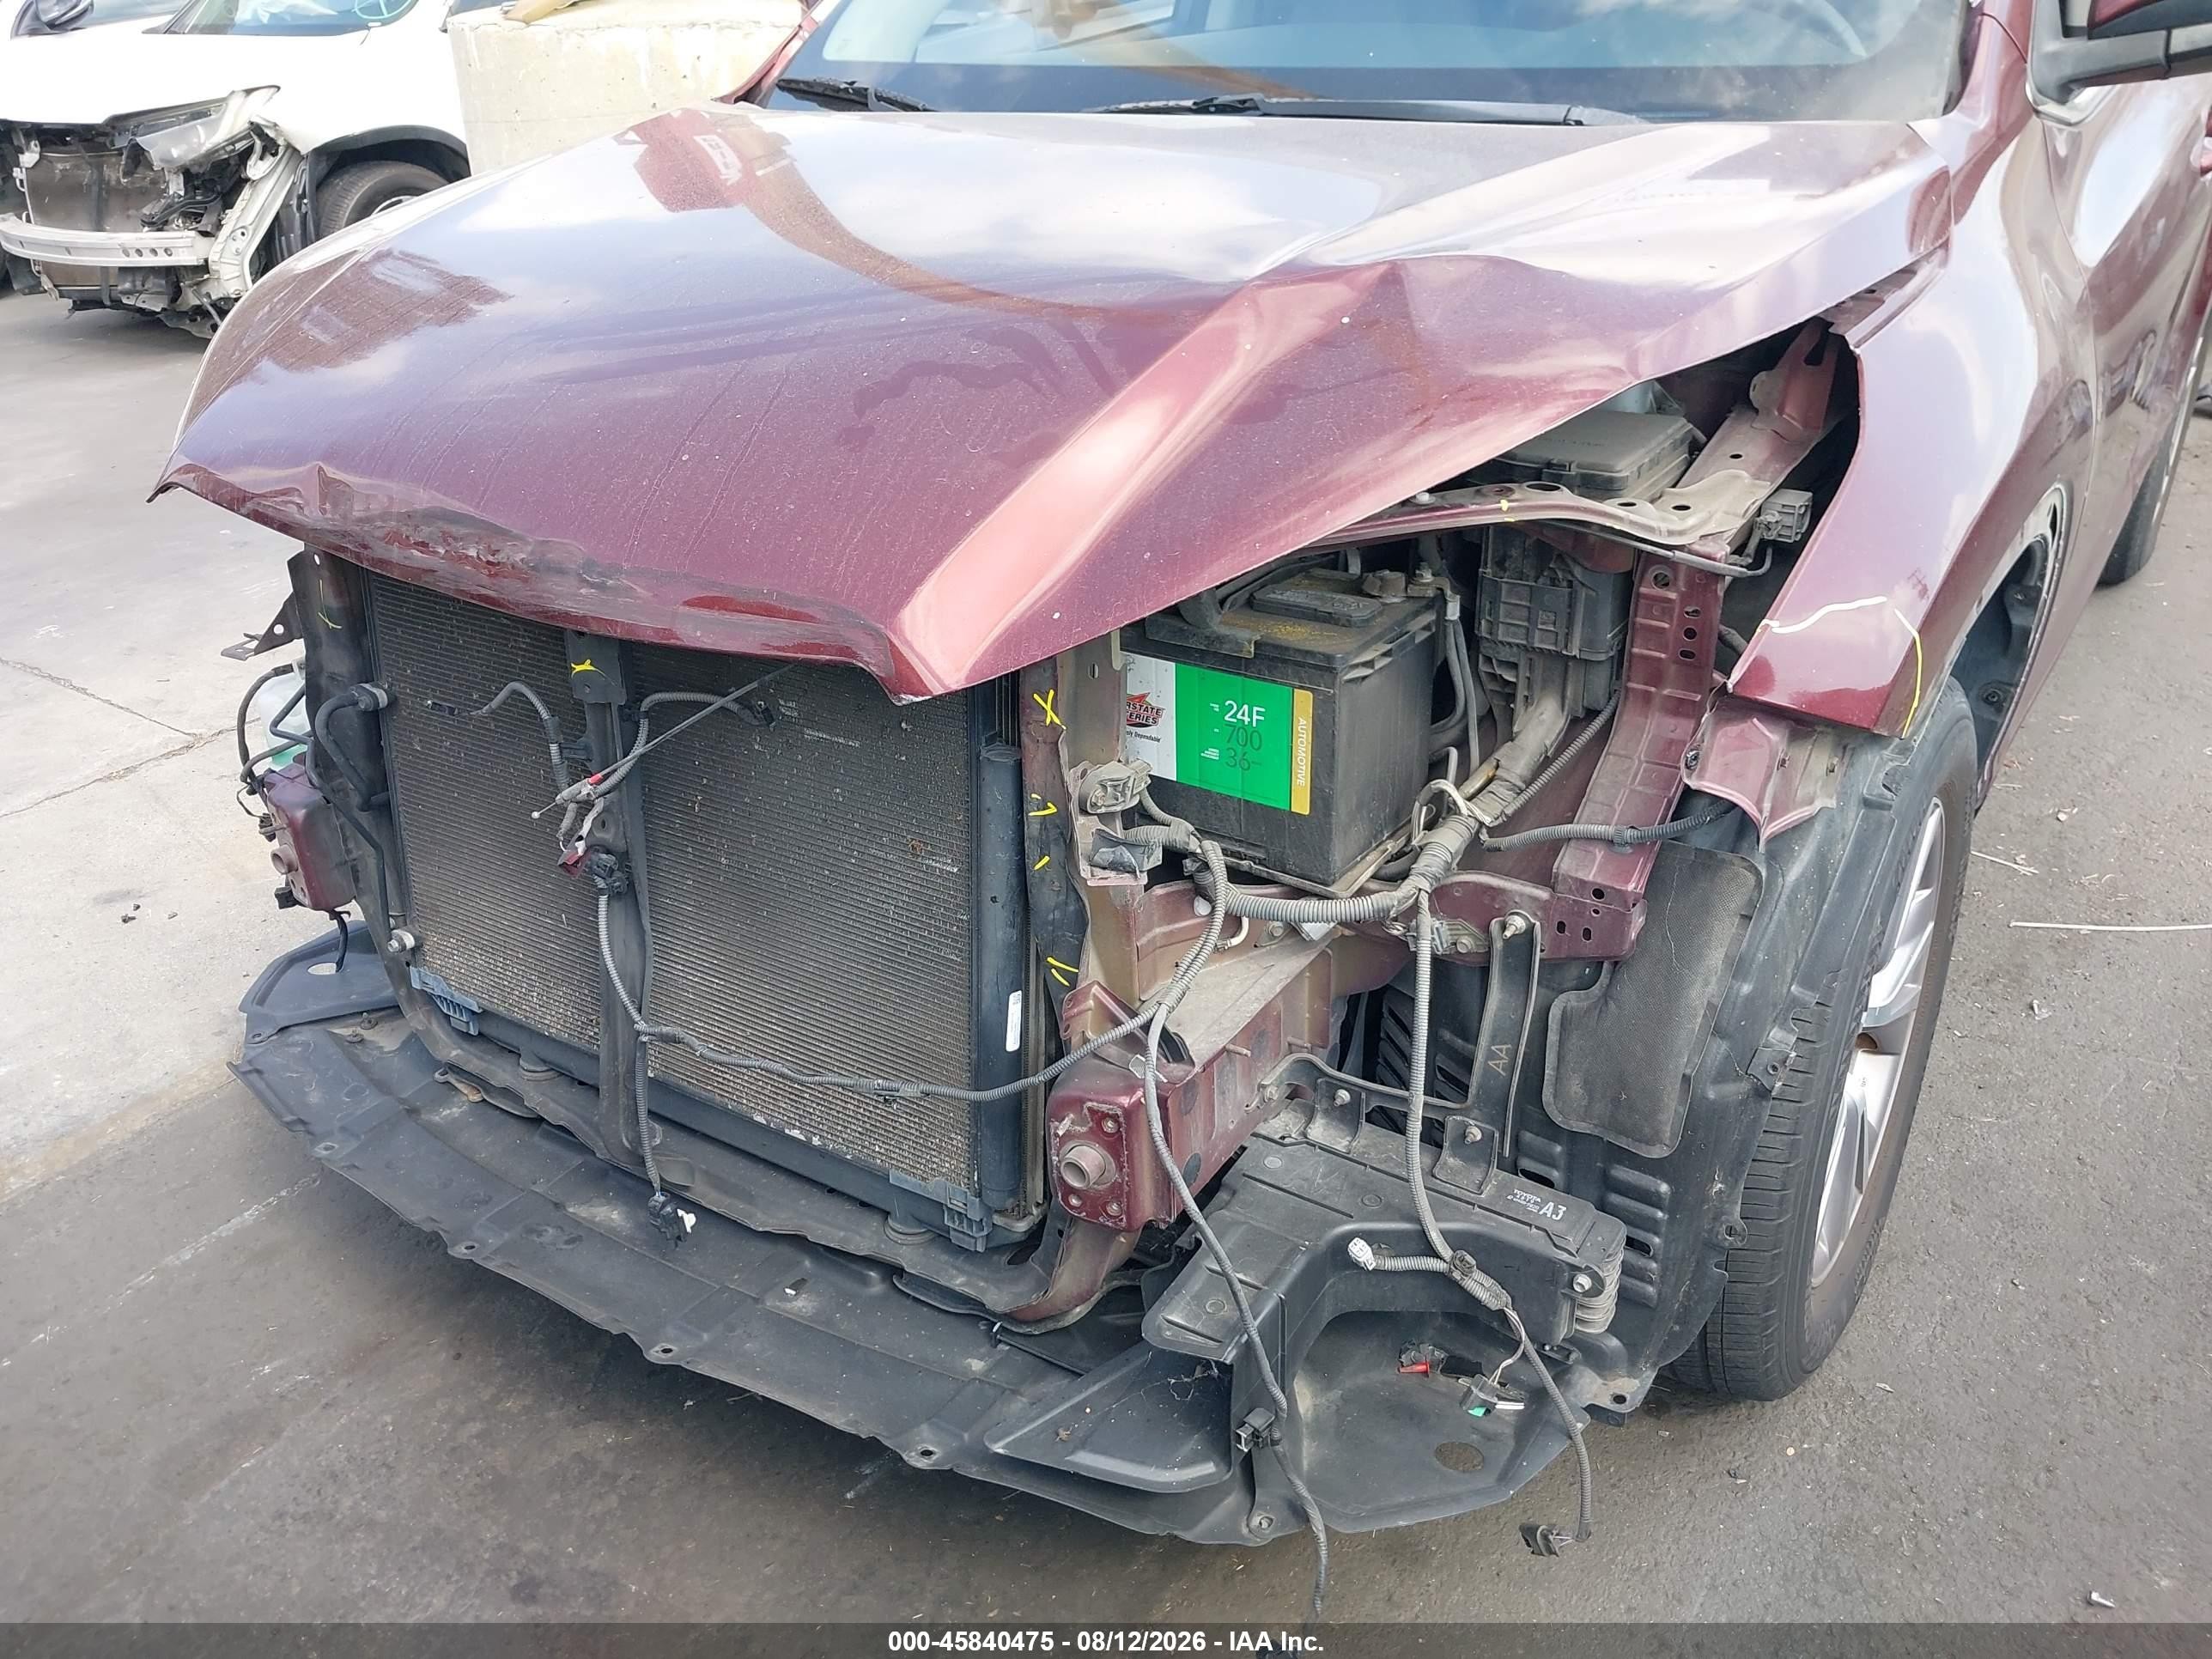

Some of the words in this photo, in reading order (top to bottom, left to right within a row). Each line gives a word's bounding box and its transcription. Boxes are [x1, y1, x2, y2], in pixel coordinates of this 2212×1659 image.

[1127, 702, 1163, 716] RSTATE
[1127, 712, 1158, 725] ERIES
[1224, 700, 1266, 727] 24F
[1224, 724, 1262, 750] 700
[1297, 717, 1307, 787] AUTOMOTIVE
[1513, 1188, 1541, 1203] TOYOTA
[1538, 1201, 1567, 1221] A3
